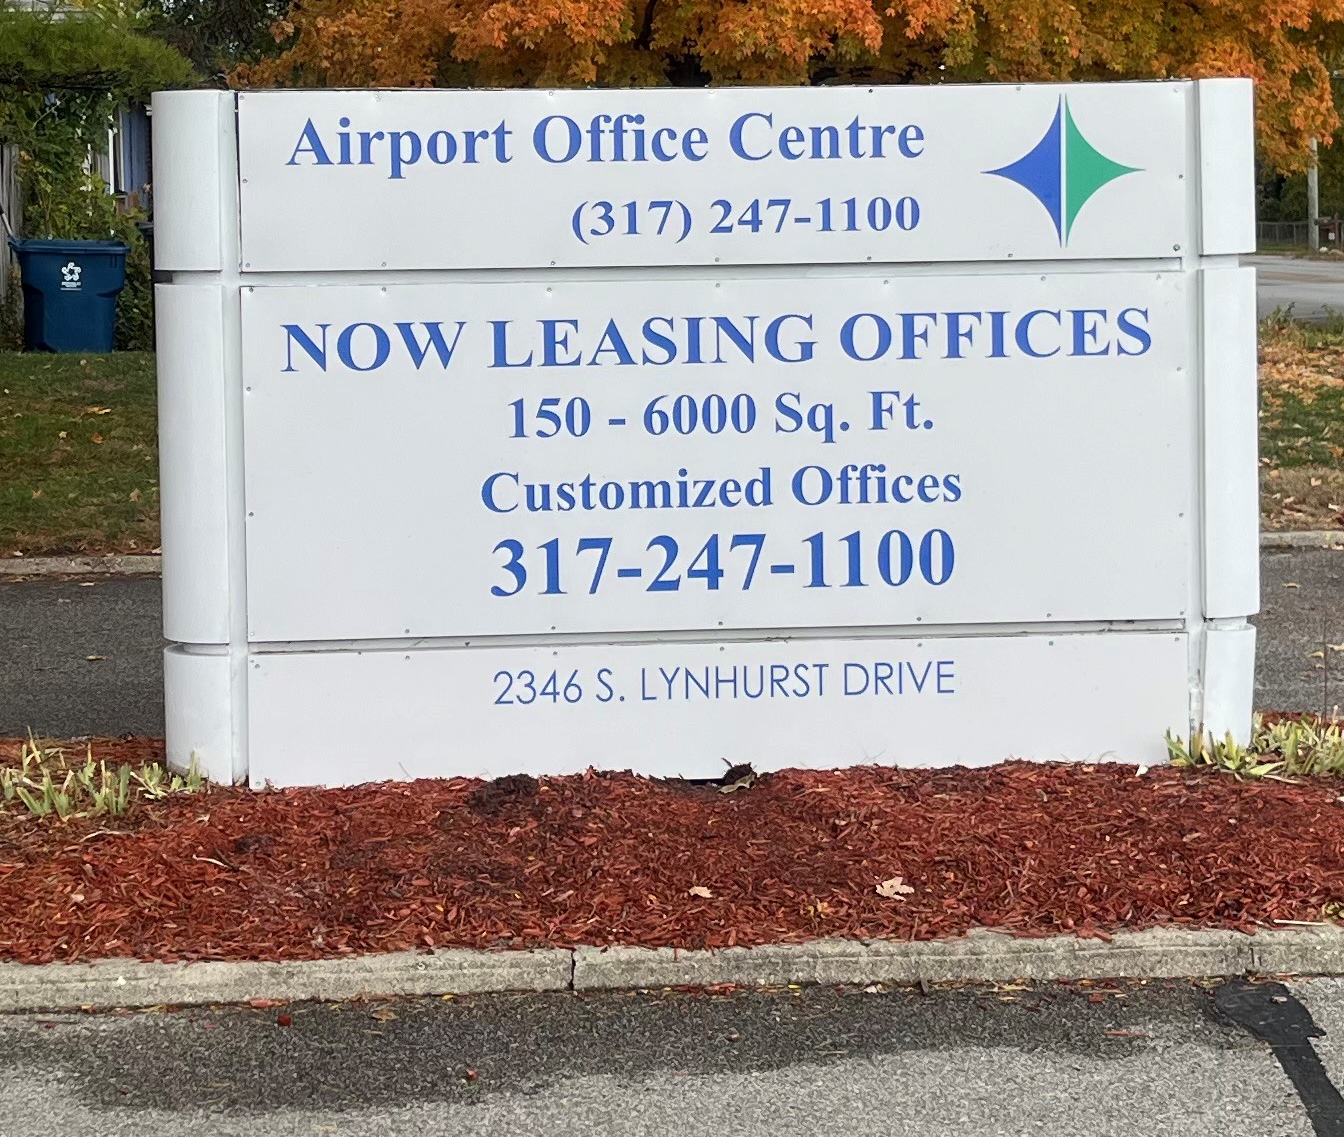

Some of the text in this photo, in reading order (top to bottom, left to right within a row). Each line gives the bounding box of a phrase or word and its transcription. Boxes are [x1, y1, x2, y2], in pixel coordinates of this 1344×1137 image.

[285, 111, 925, 180] Airport Office Centre
[571, 196, 921, 244] (317) 247-1100
[282, 307, 1152, 373] NOW LEASING OFFICES
[510, 396, 592, 439] 150
[643, 393, 758, 435] 6000
[775, 393, 850, 444] Sq.
[870, 390, 934, 432] Ft.
[480, 462, 963, 513] Customized Offices
[490, 527, 956, 598] 317-247-1100
[493, 660, 956, 705] 2346 S. LYNHURST DRIVE
